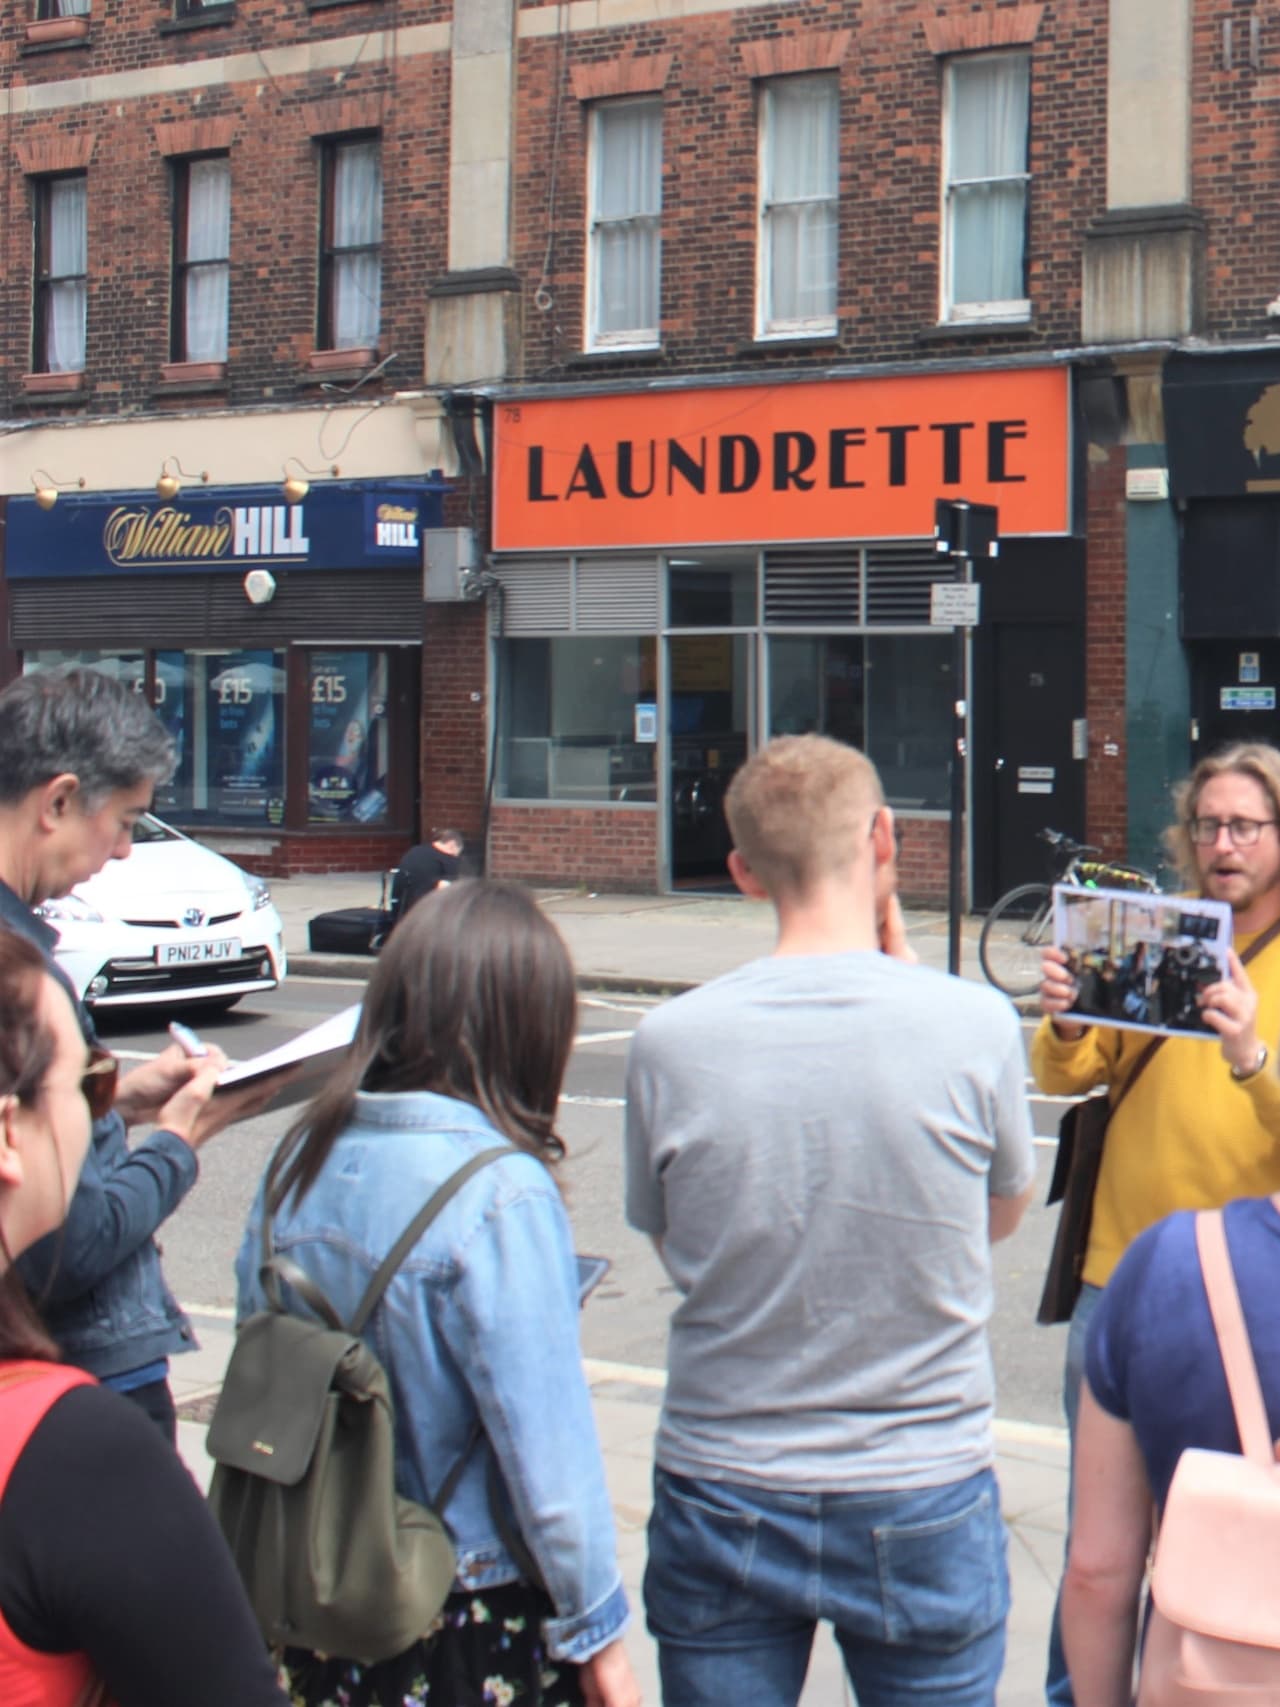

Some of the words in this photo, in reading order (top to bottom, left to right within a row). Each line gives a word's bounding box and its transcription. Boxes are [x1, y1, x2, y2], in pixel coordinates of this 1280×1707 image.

[504, 406, 522, 424] 78
[526, 419, 1028, 502] LAUNDRETTE
[103, 506, 235, 561] William
[233, 505, 309, 556] HILL
[376, 522, 419, 547] HILL
[218, 678, 254, 704] £15
[312, 675, 347, 703] £15
[168, 945, 201, 963] PN12
